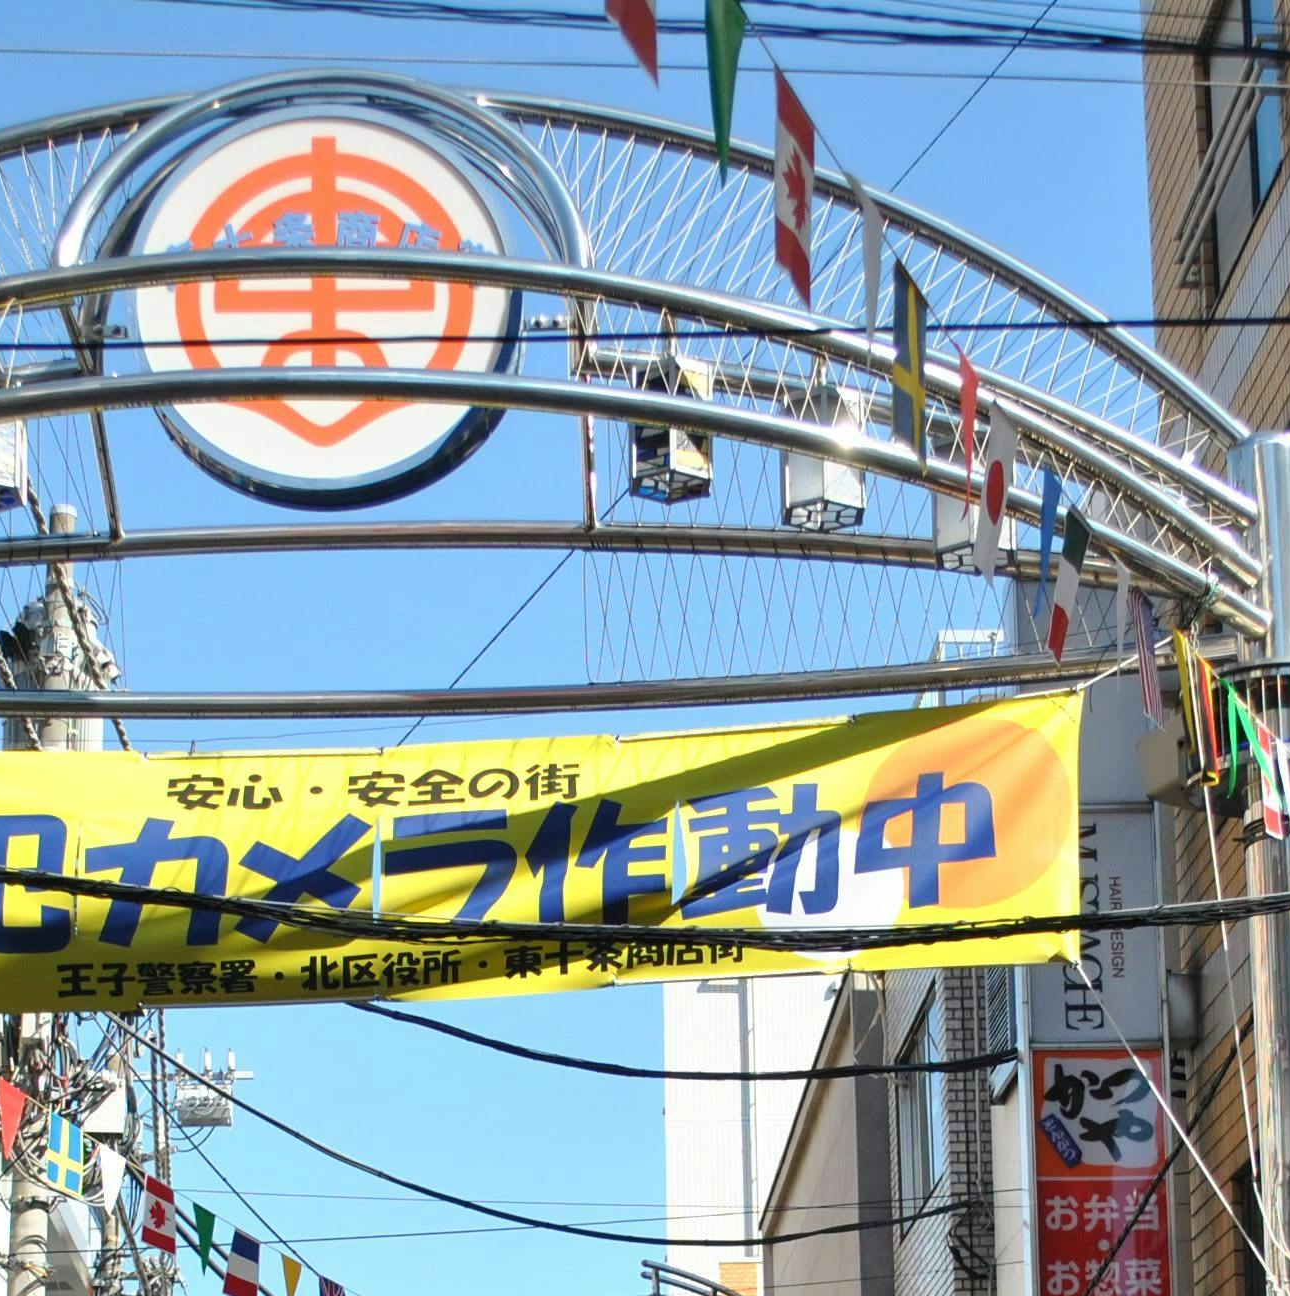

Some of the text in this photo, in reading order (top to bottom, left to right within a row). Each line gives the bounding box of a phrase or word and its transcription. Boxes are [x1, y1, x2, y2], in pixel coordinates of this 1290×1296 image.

[166, 762, 580, 811] 安心・安全の街
[1109, 922, 1125, 979] ESIGN
[1044, 1188, 1161, 1235] お弁当
